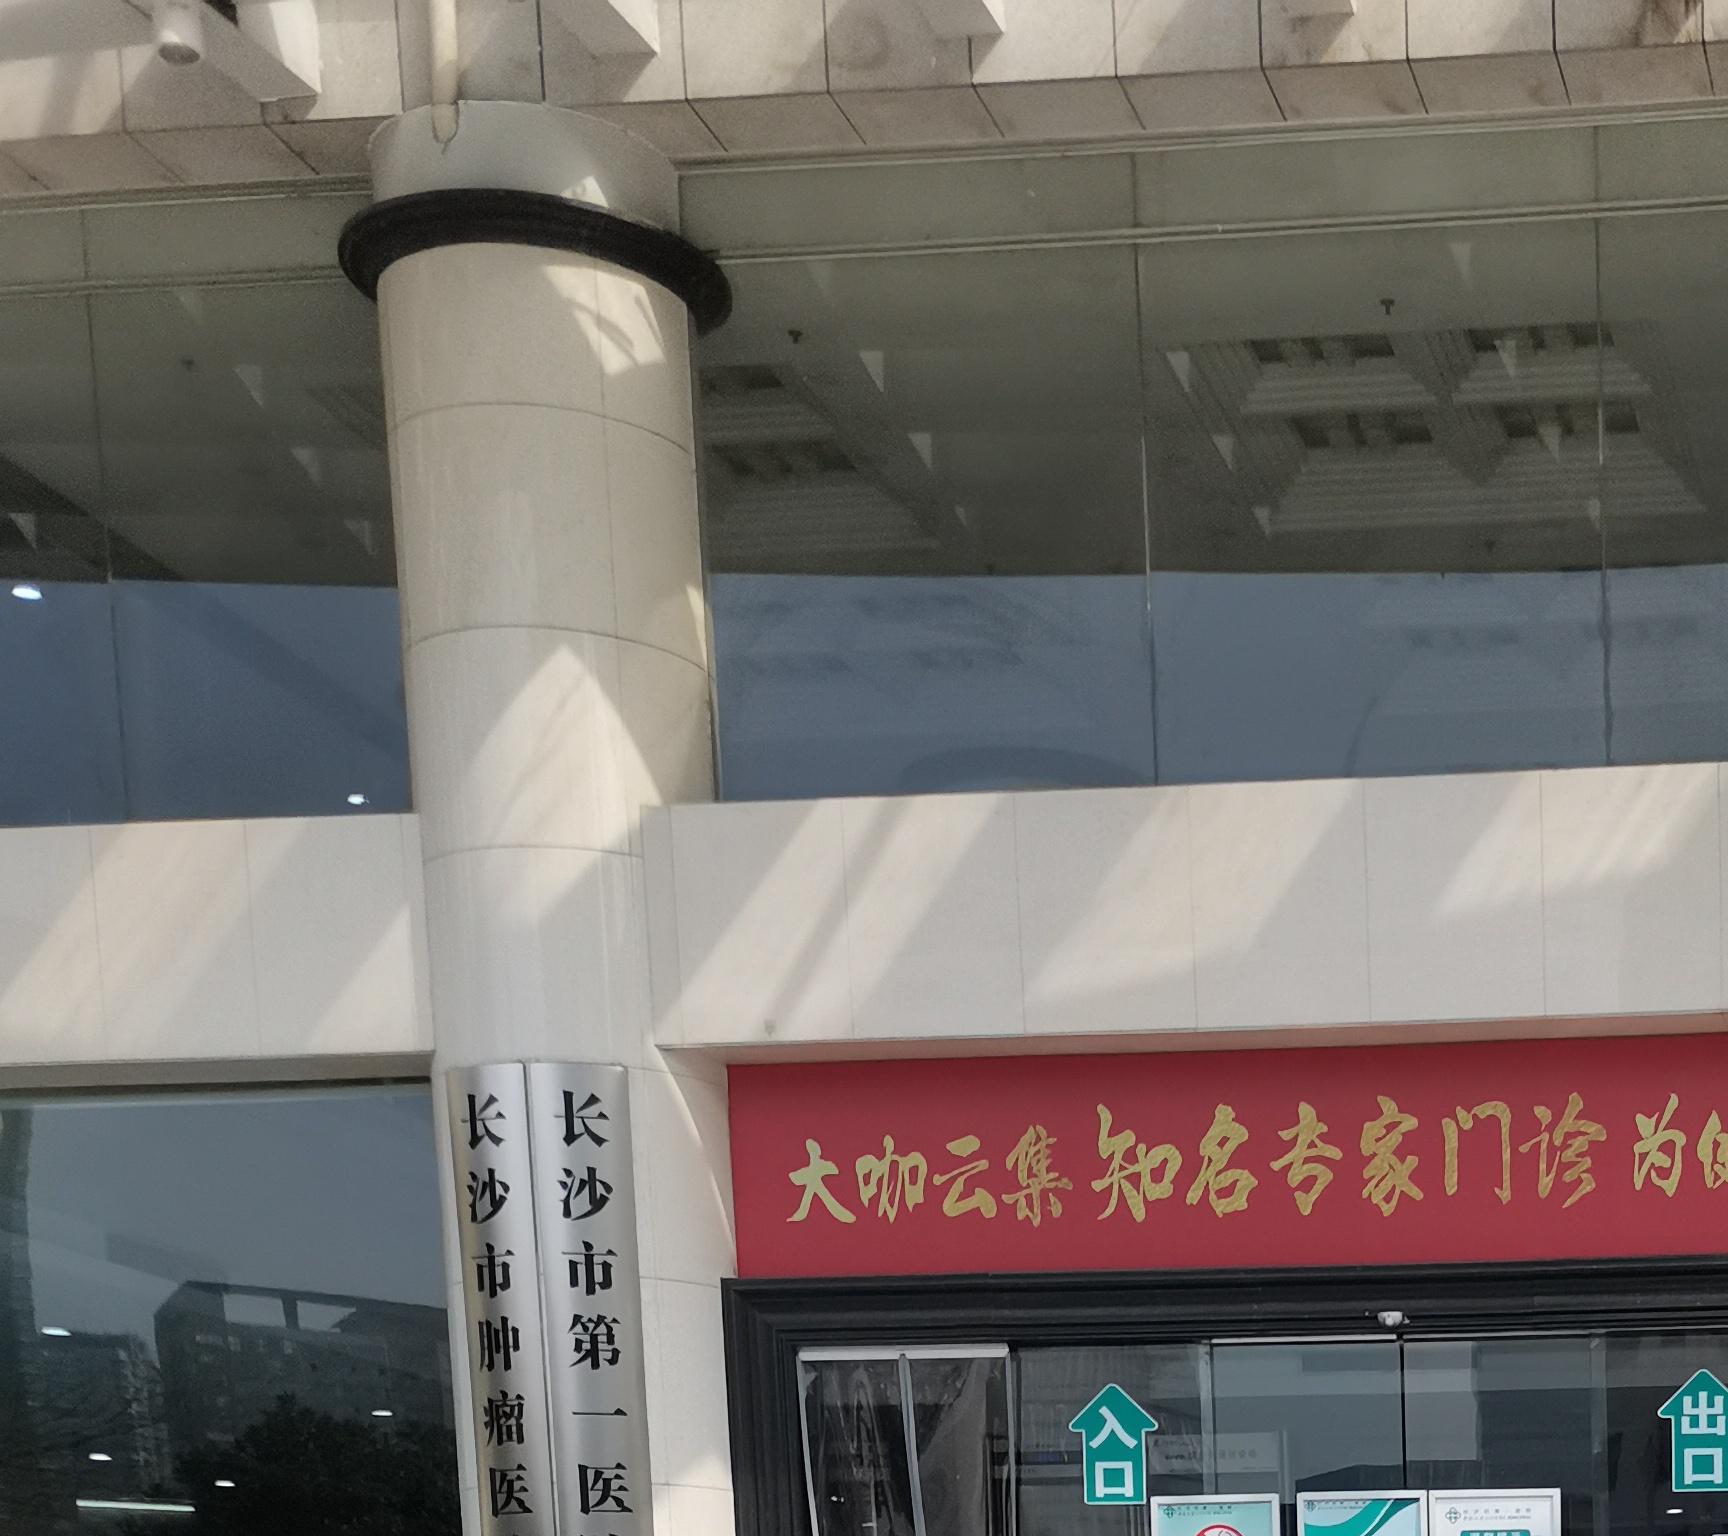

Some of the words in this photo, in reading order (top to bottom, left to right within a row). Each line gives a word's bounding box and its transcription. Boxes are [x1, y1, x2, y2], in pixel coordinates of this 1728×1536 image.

[786, 1123, 1073, 1227] 大咖云集
[1091, 1092, 1607, 1223] 知名专家门诊
[1088, 1405, 1138, 1498] 入口
[1681, 1391, 1726, 1485] 出口
